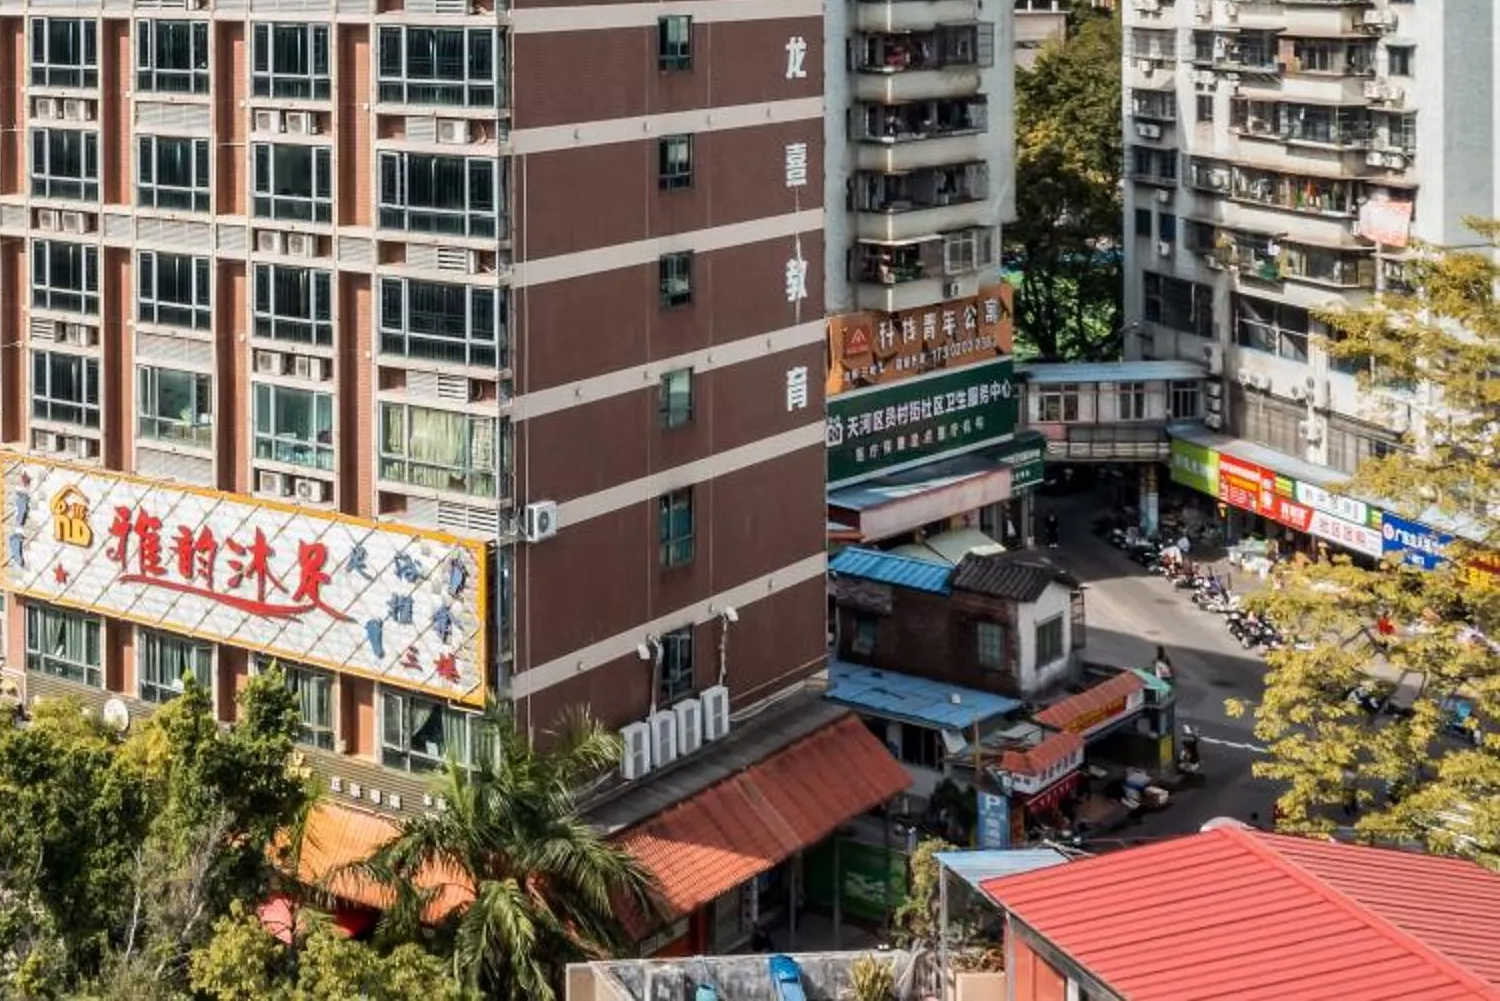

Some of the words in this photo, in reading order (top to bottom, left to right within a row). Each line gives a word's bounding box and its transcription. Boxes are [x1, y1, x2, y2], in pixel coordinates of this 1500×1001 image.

[879, 298, 998, 350] 科技青年公寓
[847, 379, 1012, 438] 天河区员村街社区卫生服务中心
[106, 505, 357, 624] 雅韵沐足
[985, 793, 1000, 811] P
